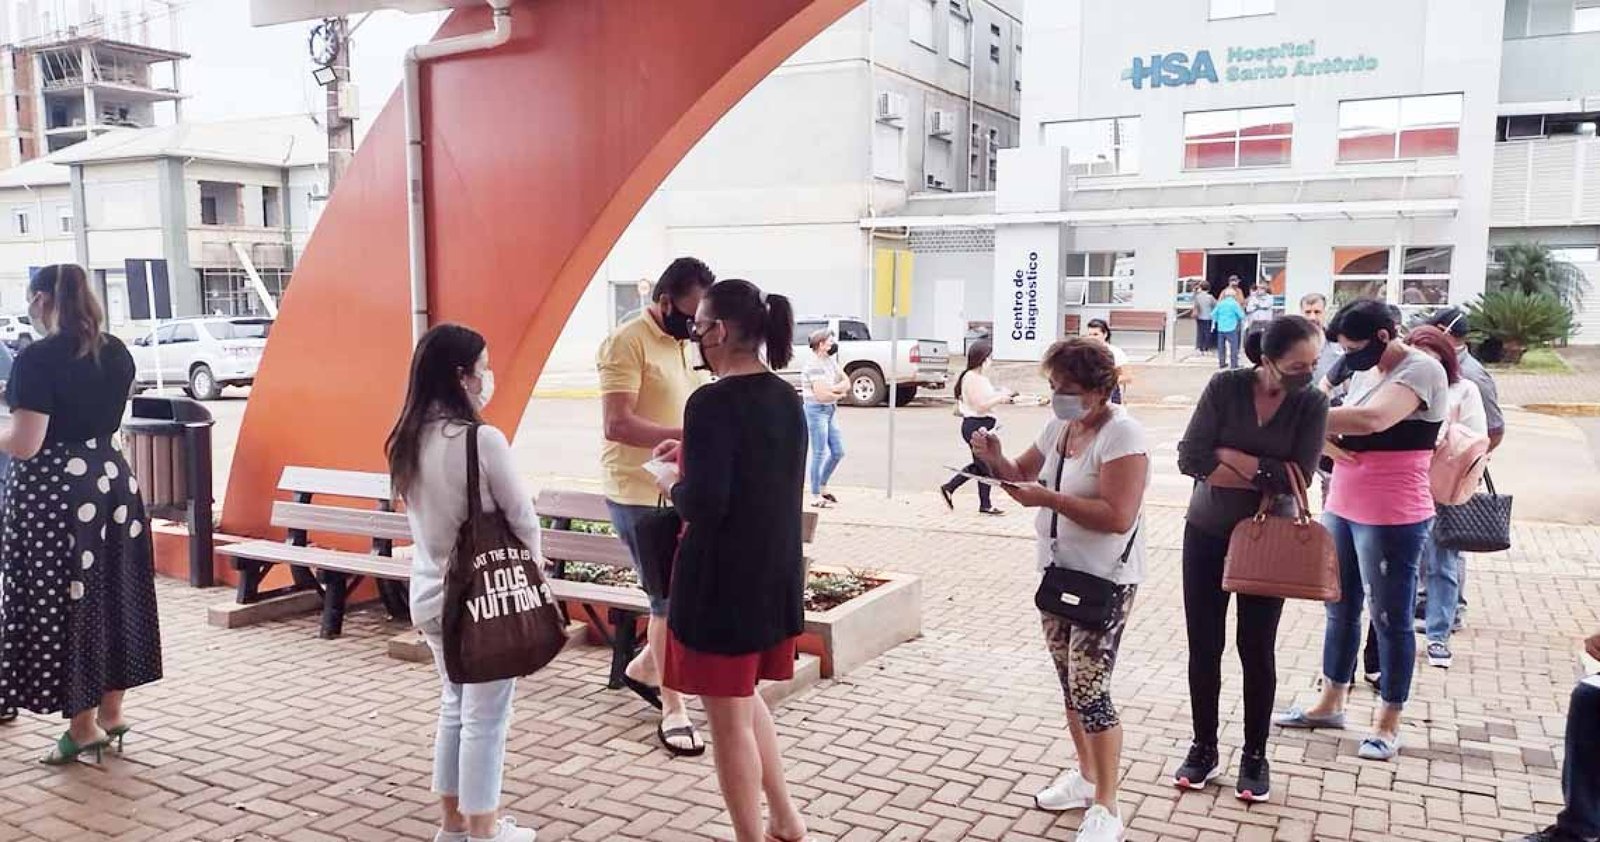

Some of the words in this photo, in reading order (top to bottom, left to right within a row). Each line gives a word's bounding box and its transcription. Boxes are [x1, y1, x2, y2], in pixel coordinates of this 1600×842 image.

[1131, 50, 1219, 89] HSA
[1227, 40, 1315, 63] Hospital
[1226, 63, 1287, 82] Santo
[1013, 269, 1024, 288] de
[1025, 251, 1039, 341] Diagnóstico
[1011, 290, 1024, 341] Centro
[466, 585, 542, 623] VUITTON
